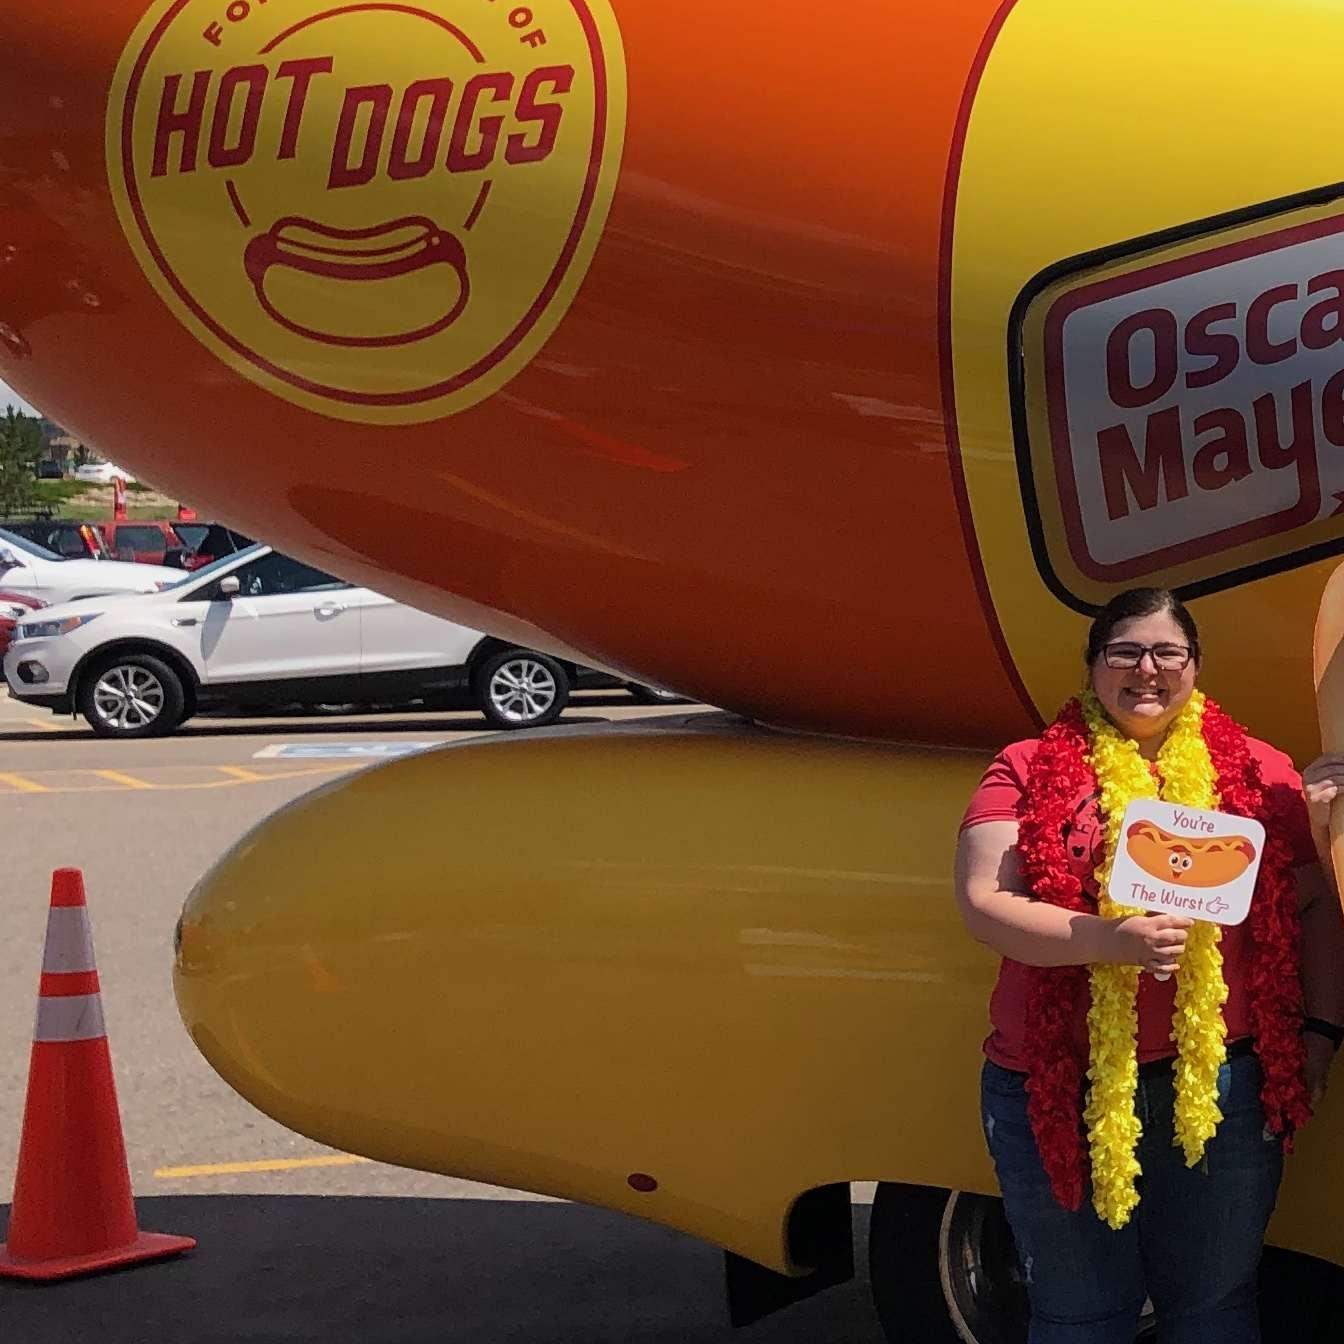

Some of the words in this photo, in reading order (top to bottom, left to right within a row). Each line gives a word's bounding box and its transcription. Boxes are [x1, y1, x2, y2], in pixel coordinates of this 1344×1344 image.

[507, 7, 547, 49] OF
[150, 56, 334, 178] HOT
[326, 64, 576, 191] DOGS
[1173, 809, 1215, 833] You're
[1130, 882, 1157, 903] The
[1160, 888, 1204, 911] Wurst
